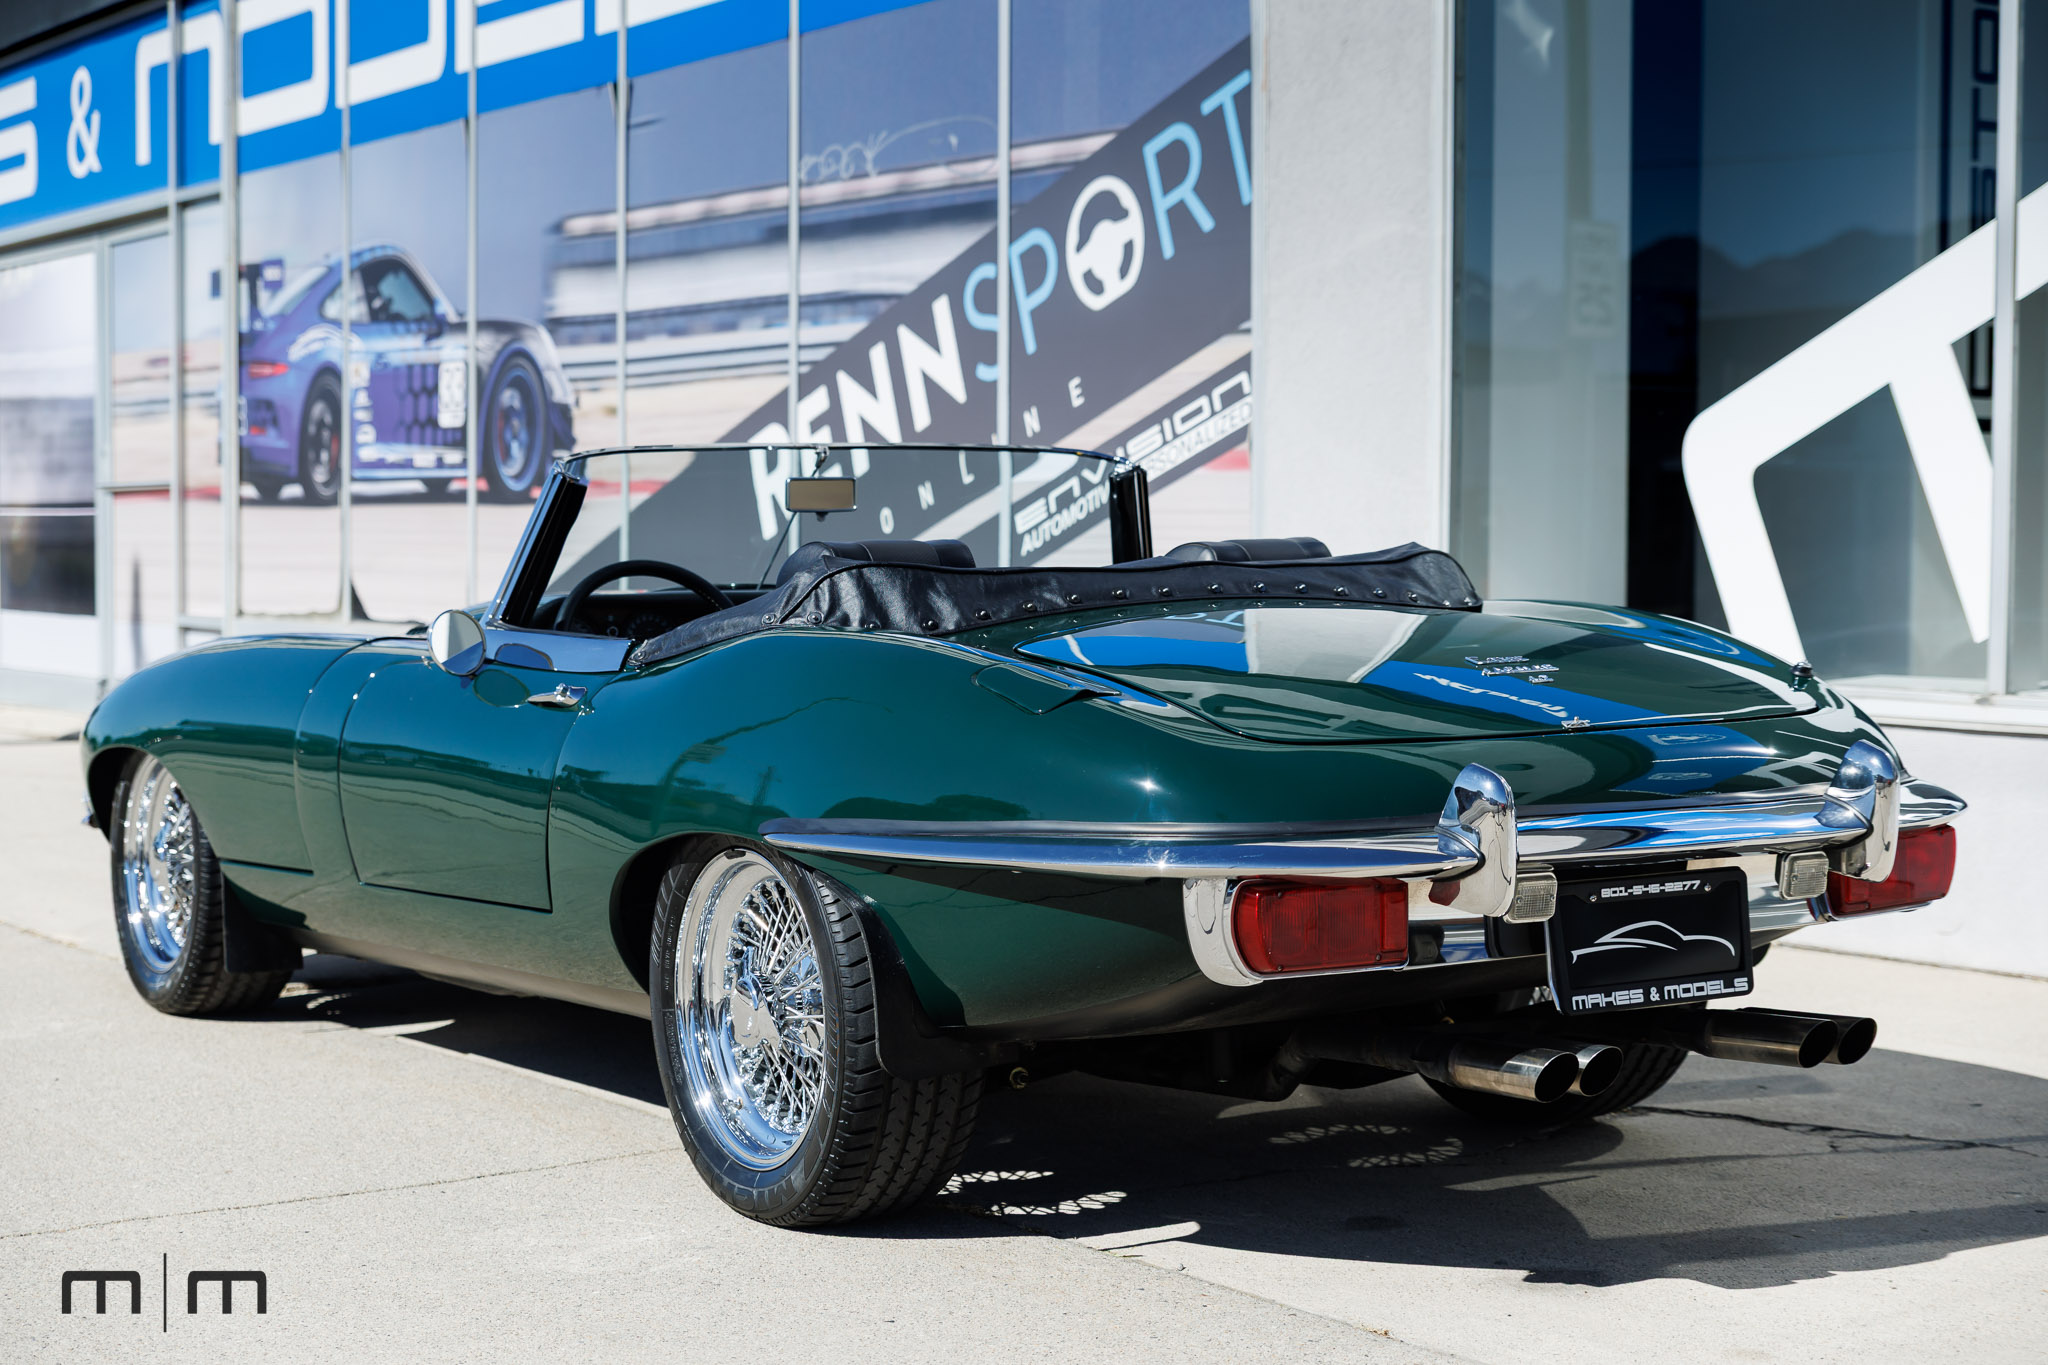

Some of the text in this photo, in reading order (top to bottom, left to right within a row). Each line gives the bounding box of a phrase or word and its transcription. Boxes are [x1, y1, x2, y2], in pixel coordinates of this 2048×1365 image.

[66, 66, 101, 178] &
[1020, 478, 1111, 557] AUTOMOTIV
[1601, 880, 1700, 898] 801-546-2277
[1572, 977, 1749, 1011] MAKES & MODELS
